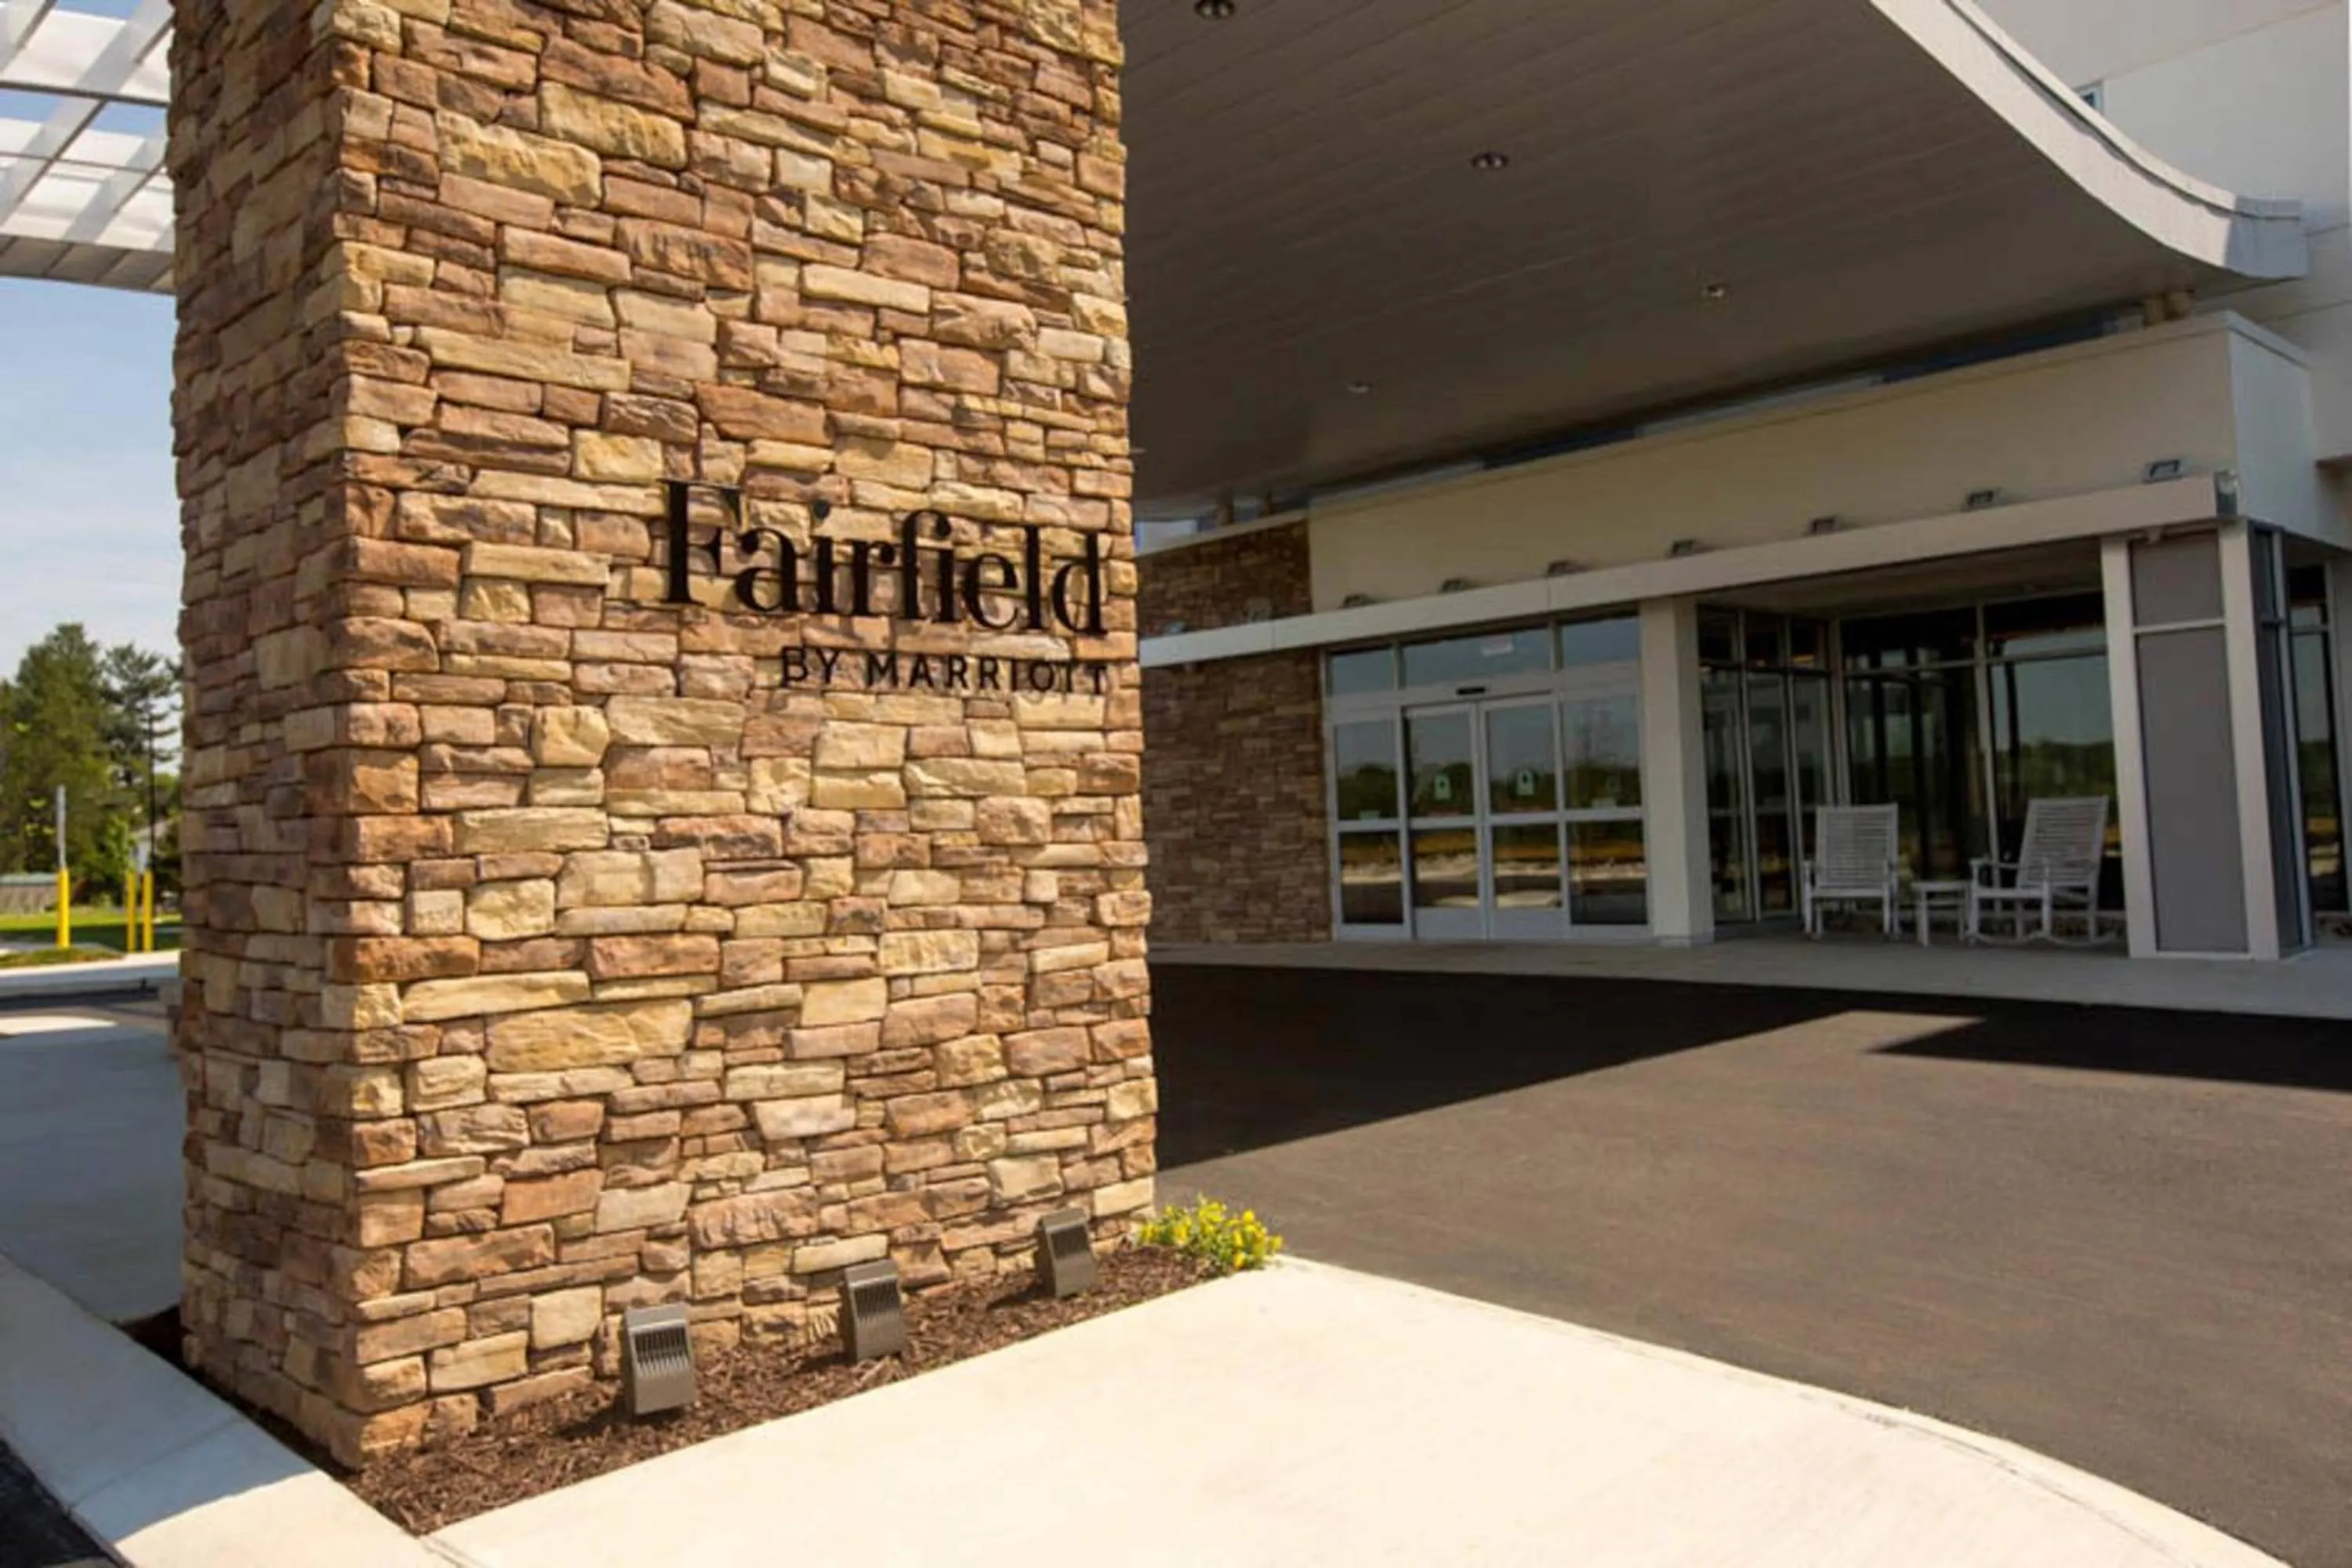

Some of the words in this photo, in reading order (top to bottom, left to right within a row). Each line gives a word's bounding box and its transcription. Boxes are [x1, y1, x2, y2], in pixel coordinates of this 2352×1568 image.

[660, 478, 1108, 637] Fairfield
[782, 647, 838, 687] BY
[867, 650, 1107, 694] MARRIOTT
